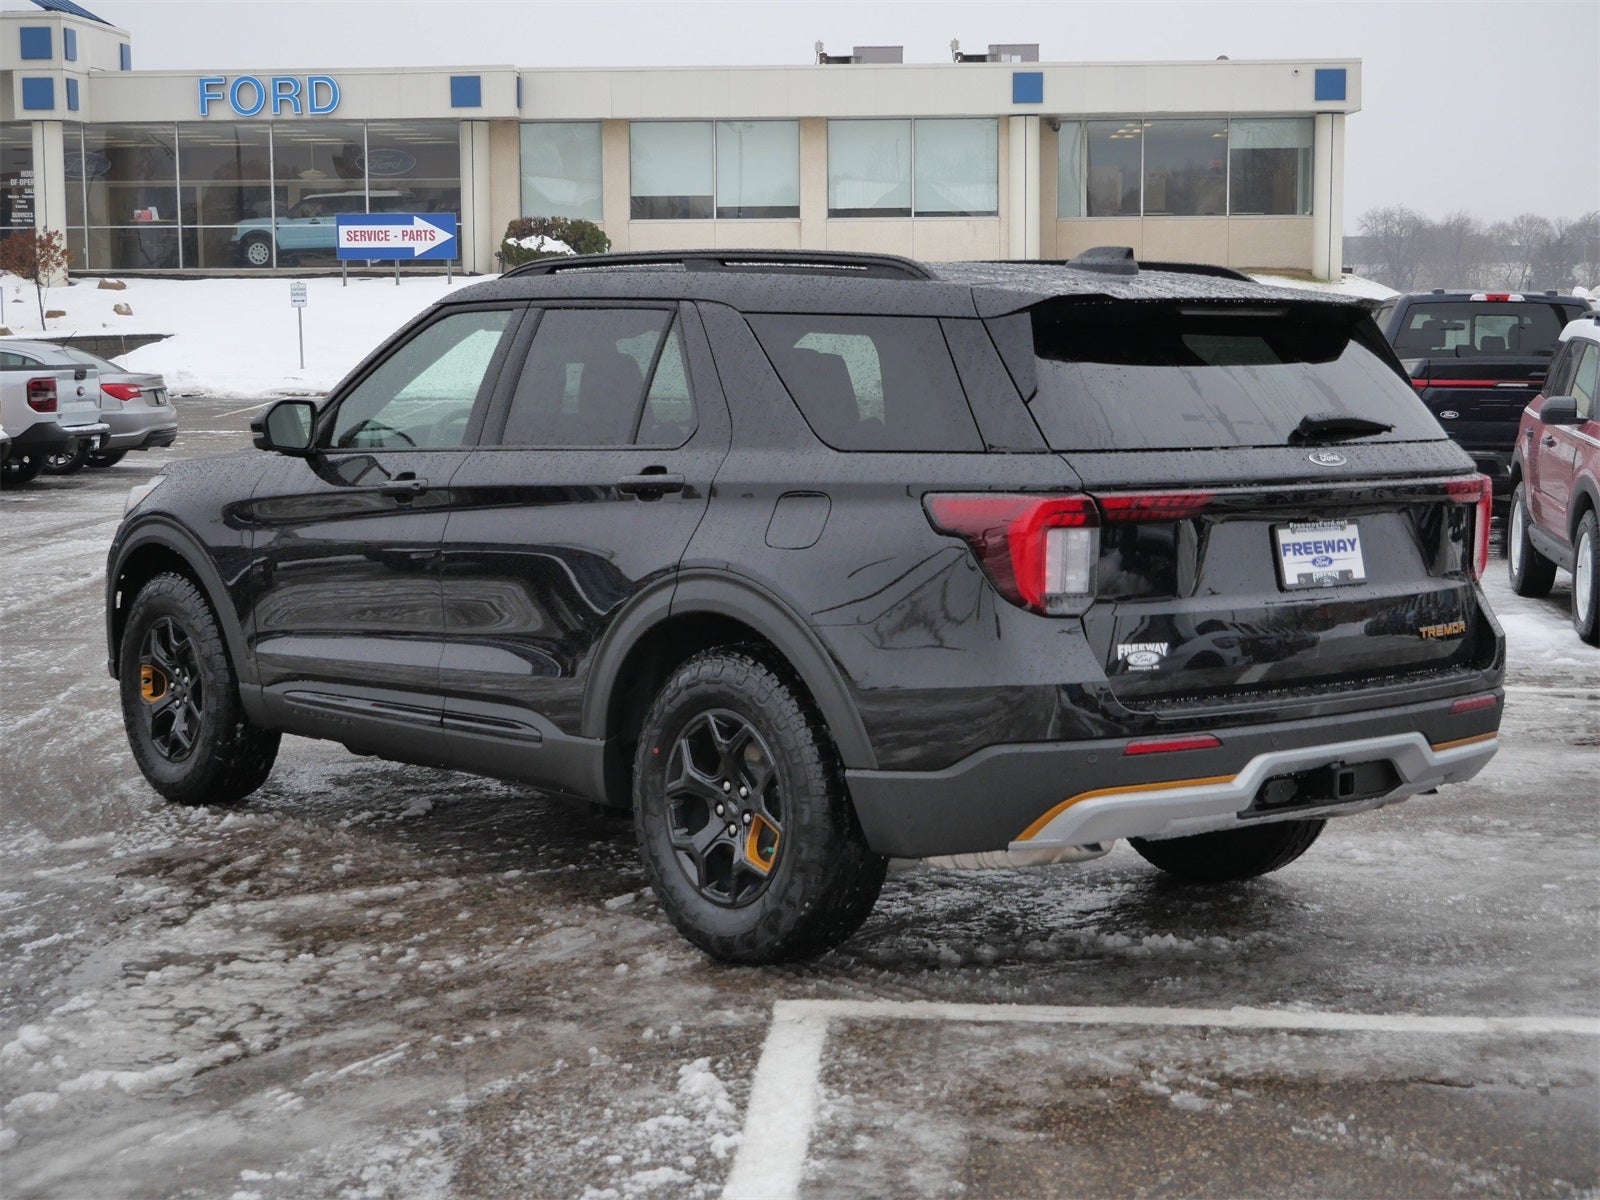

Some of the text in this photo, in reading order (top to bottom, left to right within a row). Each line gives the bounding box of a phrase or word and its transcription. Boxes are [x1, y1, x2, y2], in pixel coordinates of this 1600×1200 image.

[198, 75, 340, 116] FORD
[20, 170, 34, 178] HOU
[346, 230, 390, 242] SERVICE
[401, 229, 436, 241] PARTS
[1281, 538, 1357, 557] FREEWAY
[1418, 620, 1466, 639] TREMOR
[1117, 642, 1168, 661] FREEWAY
